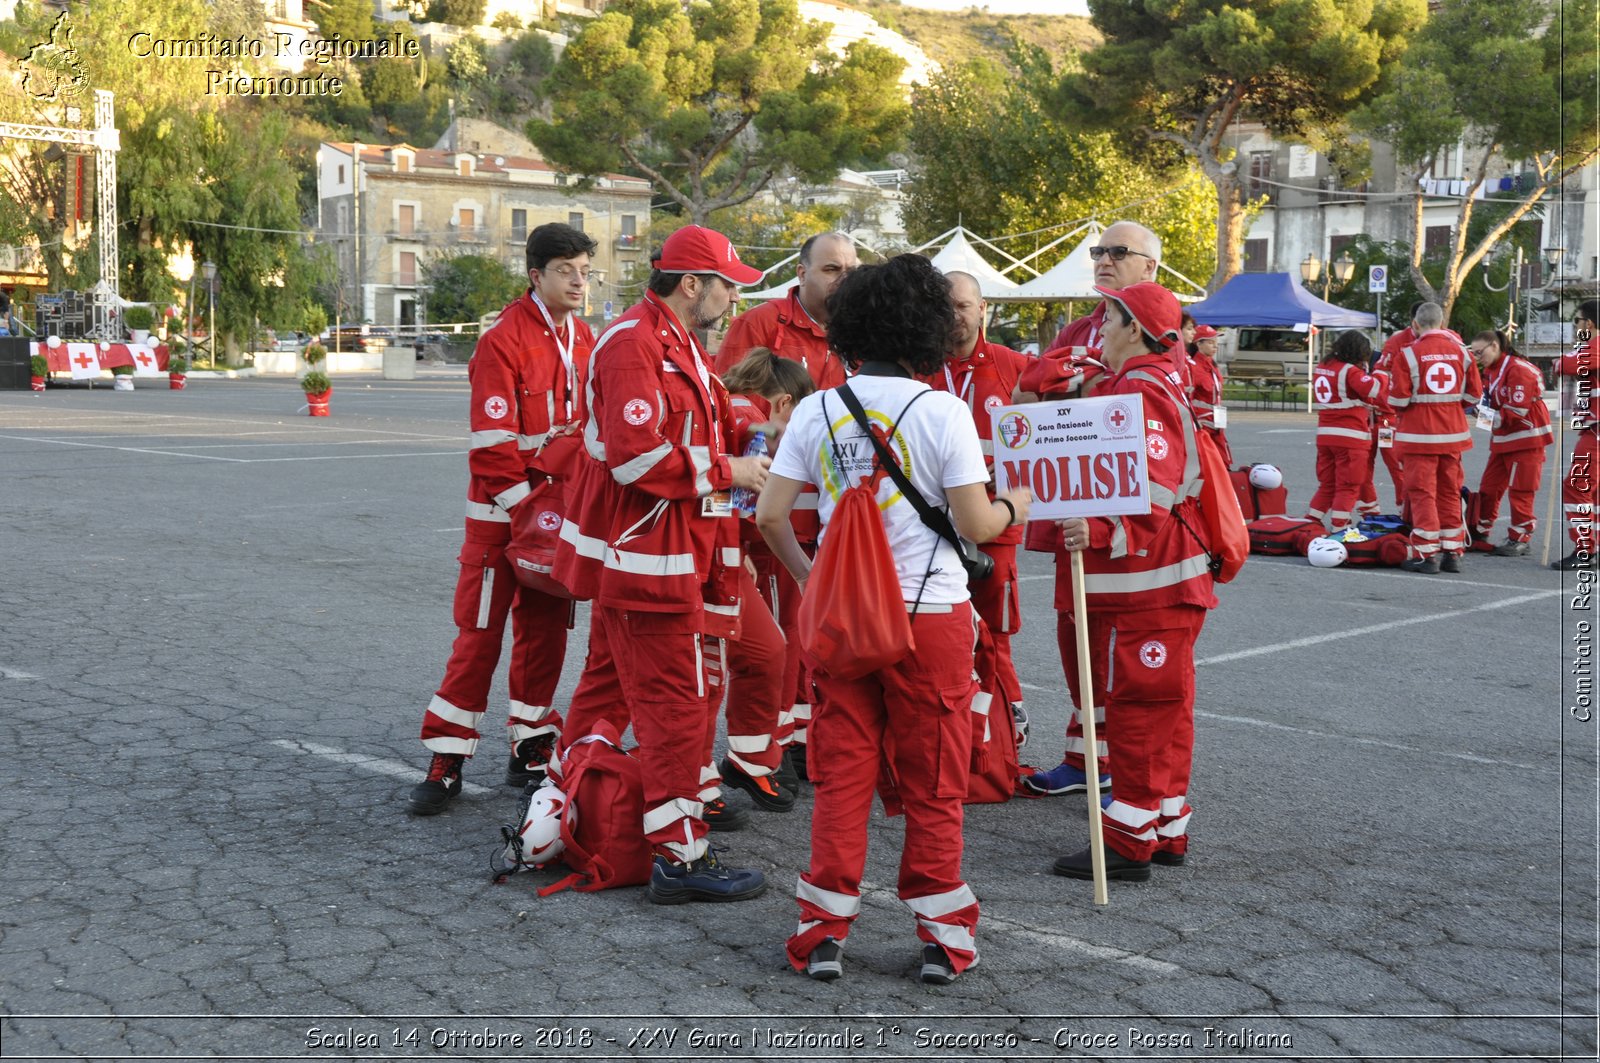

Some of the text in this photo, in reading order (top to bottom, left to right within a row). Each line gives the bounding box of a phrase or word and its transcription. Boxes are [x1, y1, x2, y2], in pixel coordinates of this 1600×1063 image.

[1057, 408, 1072, 416] XXV
[1037, 420, 1093, 431] Gara Nazionale
[1035, 433, 1098, 445] di Primo Soccorso
[832, 443, 858, 458] XXV
[1002, 451, 1141, 503] MOLISE
